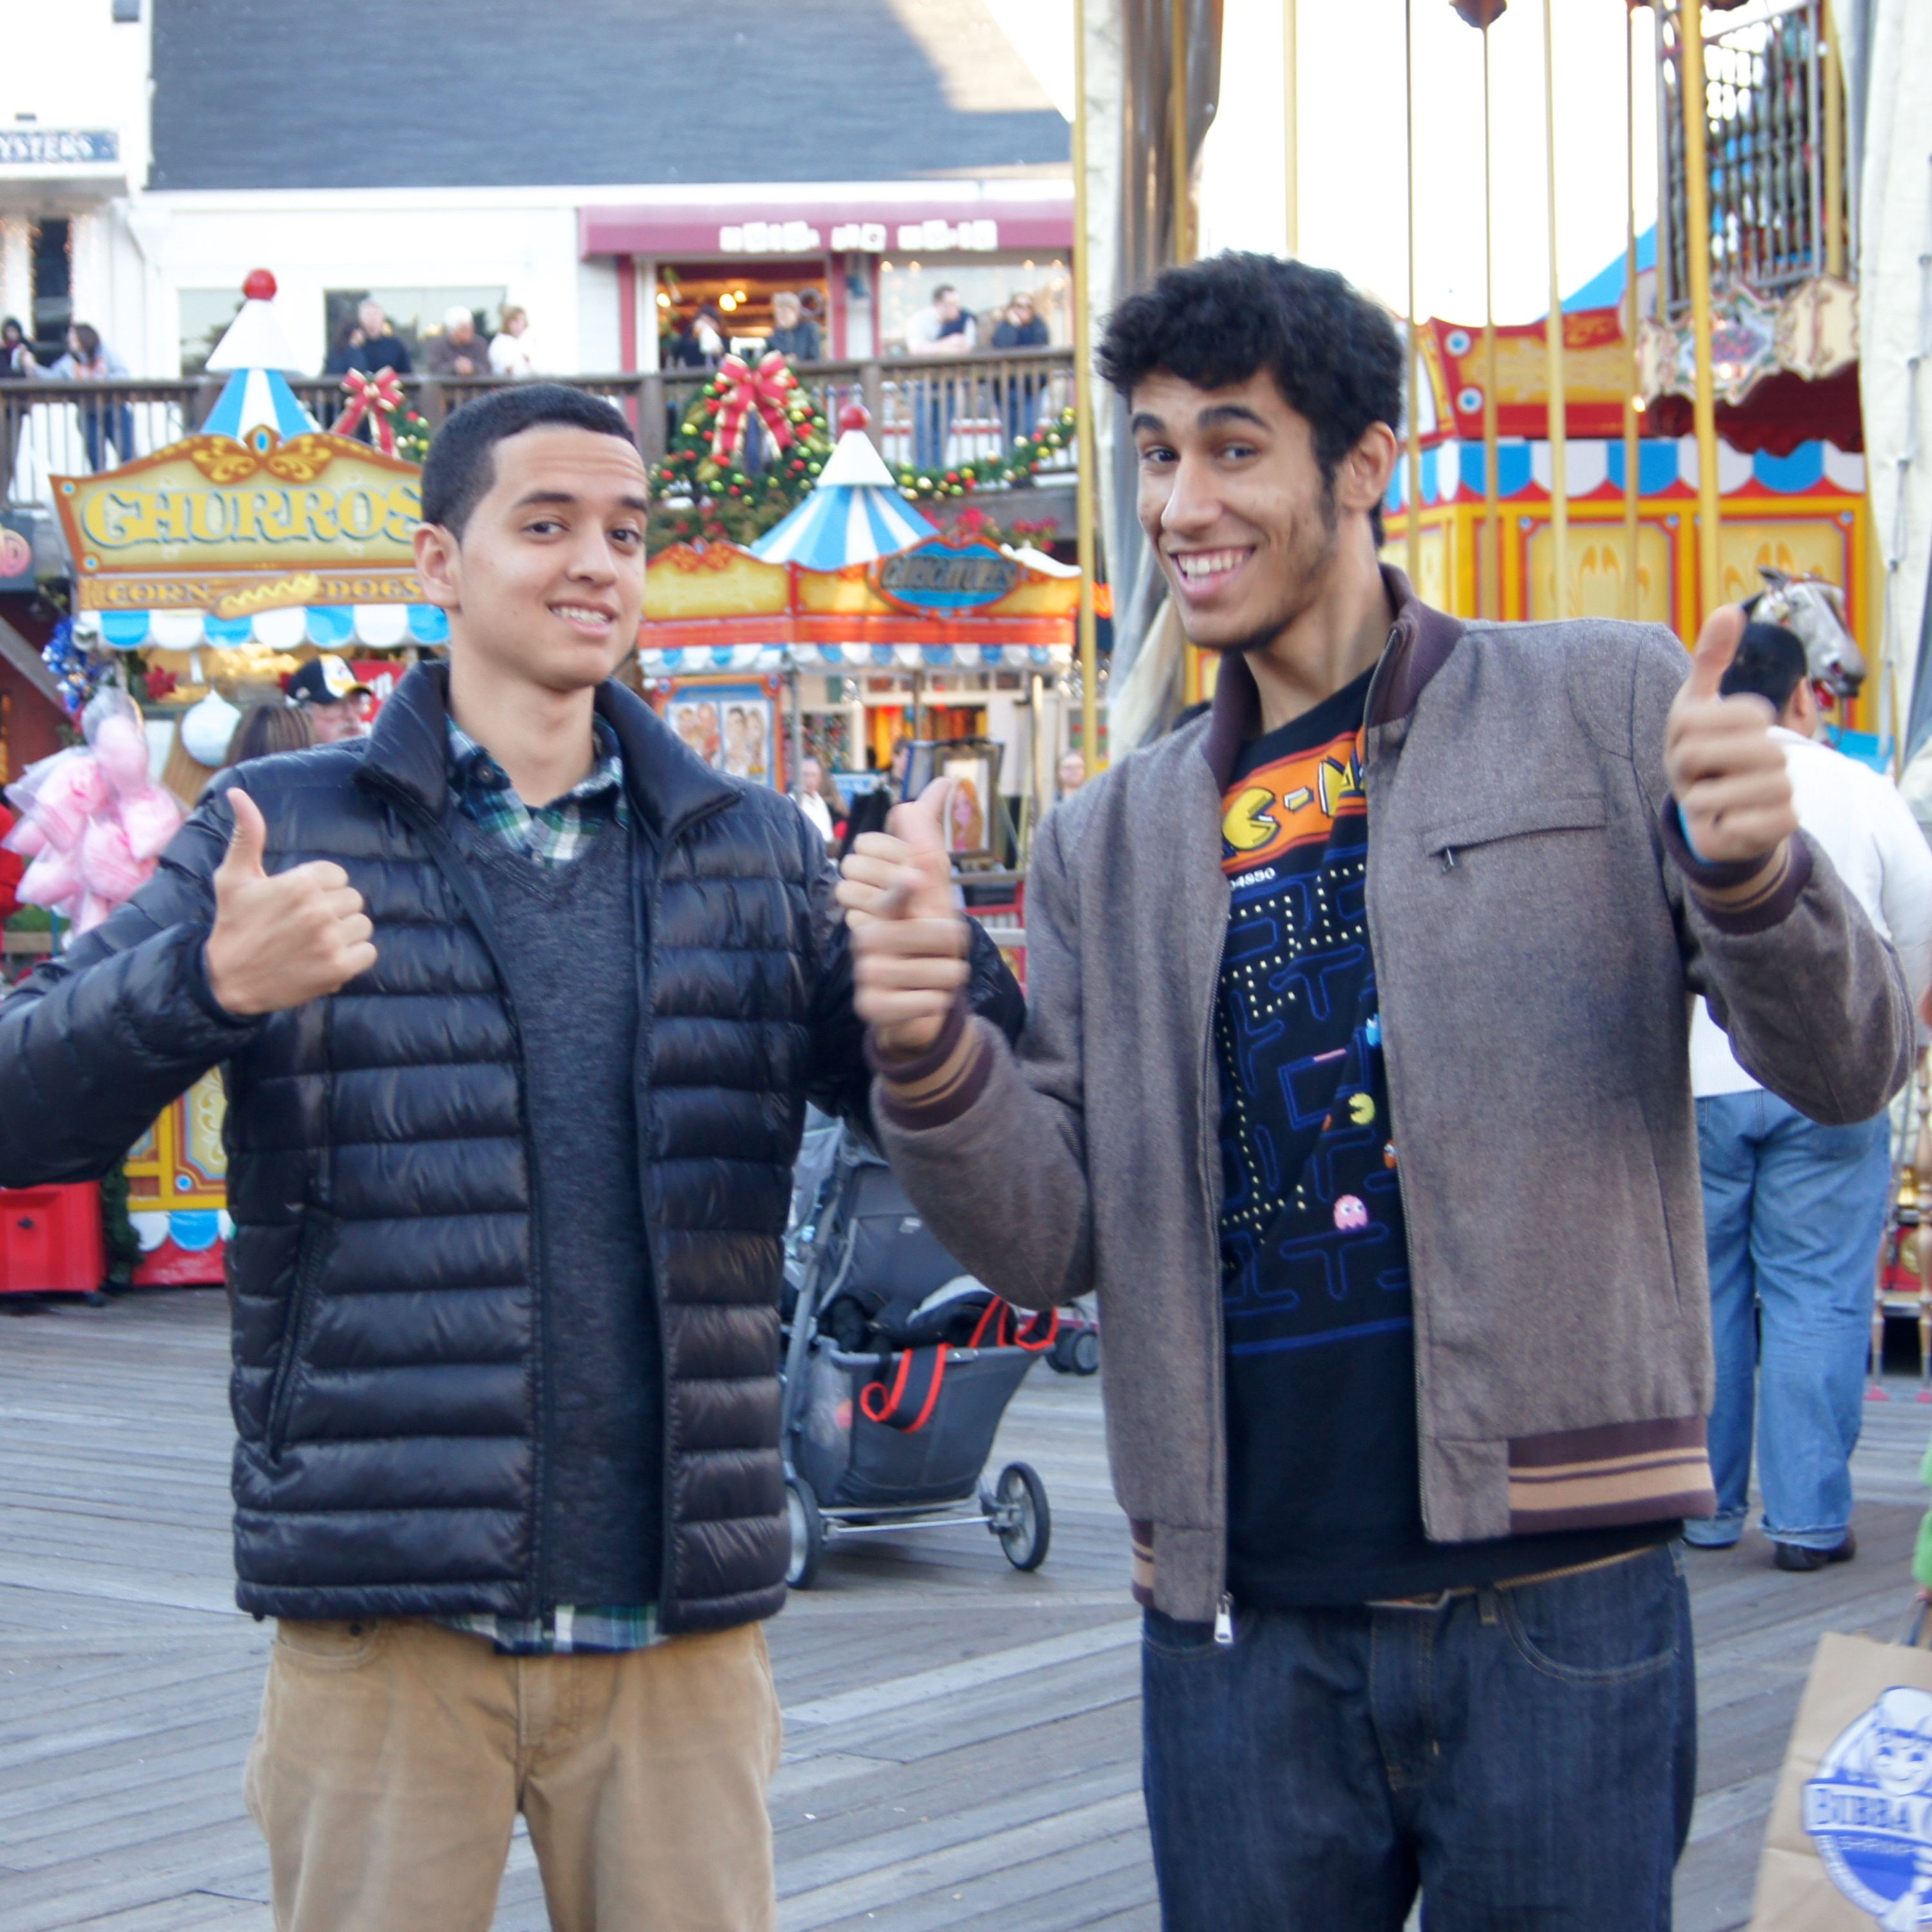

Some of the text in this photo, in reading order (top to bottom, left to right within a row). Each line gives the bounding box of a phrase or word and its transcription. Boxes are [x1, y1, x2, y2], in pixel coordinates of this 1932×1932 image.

[82, 484, 422, 549] CHURROS
[106, 579, 422, 604] CORN DOGS
